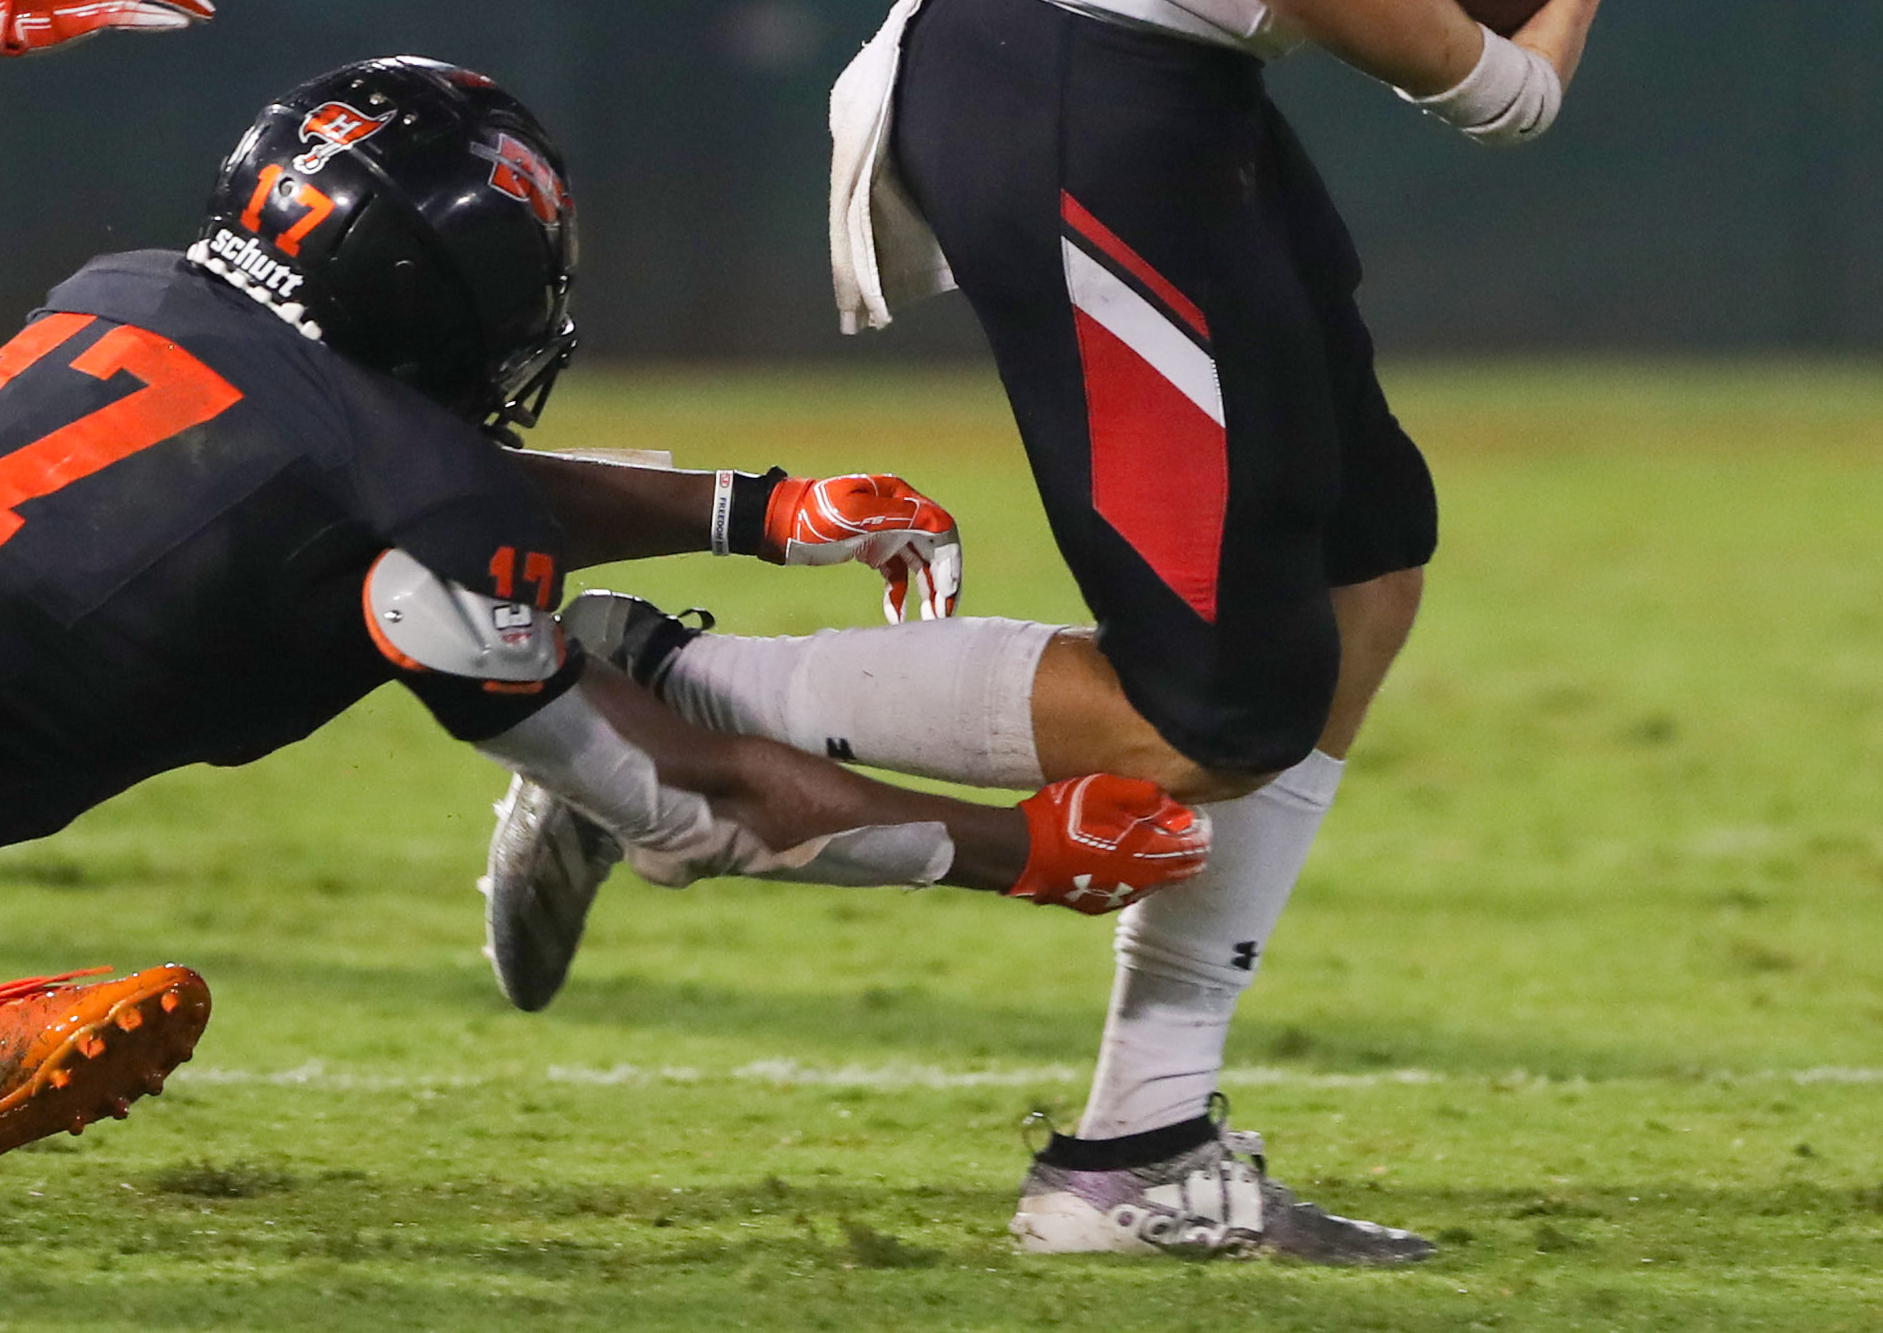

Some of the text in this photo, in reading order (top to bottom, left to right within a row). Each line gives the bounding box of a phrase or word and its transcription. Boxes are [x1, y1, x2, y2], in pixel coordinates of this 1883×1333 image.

[322, 113, 363, 139] H
[241, 164, 336, 258] 17
[209, 228, 305, 298] schutt
[488, 545, 555, 609] 17
